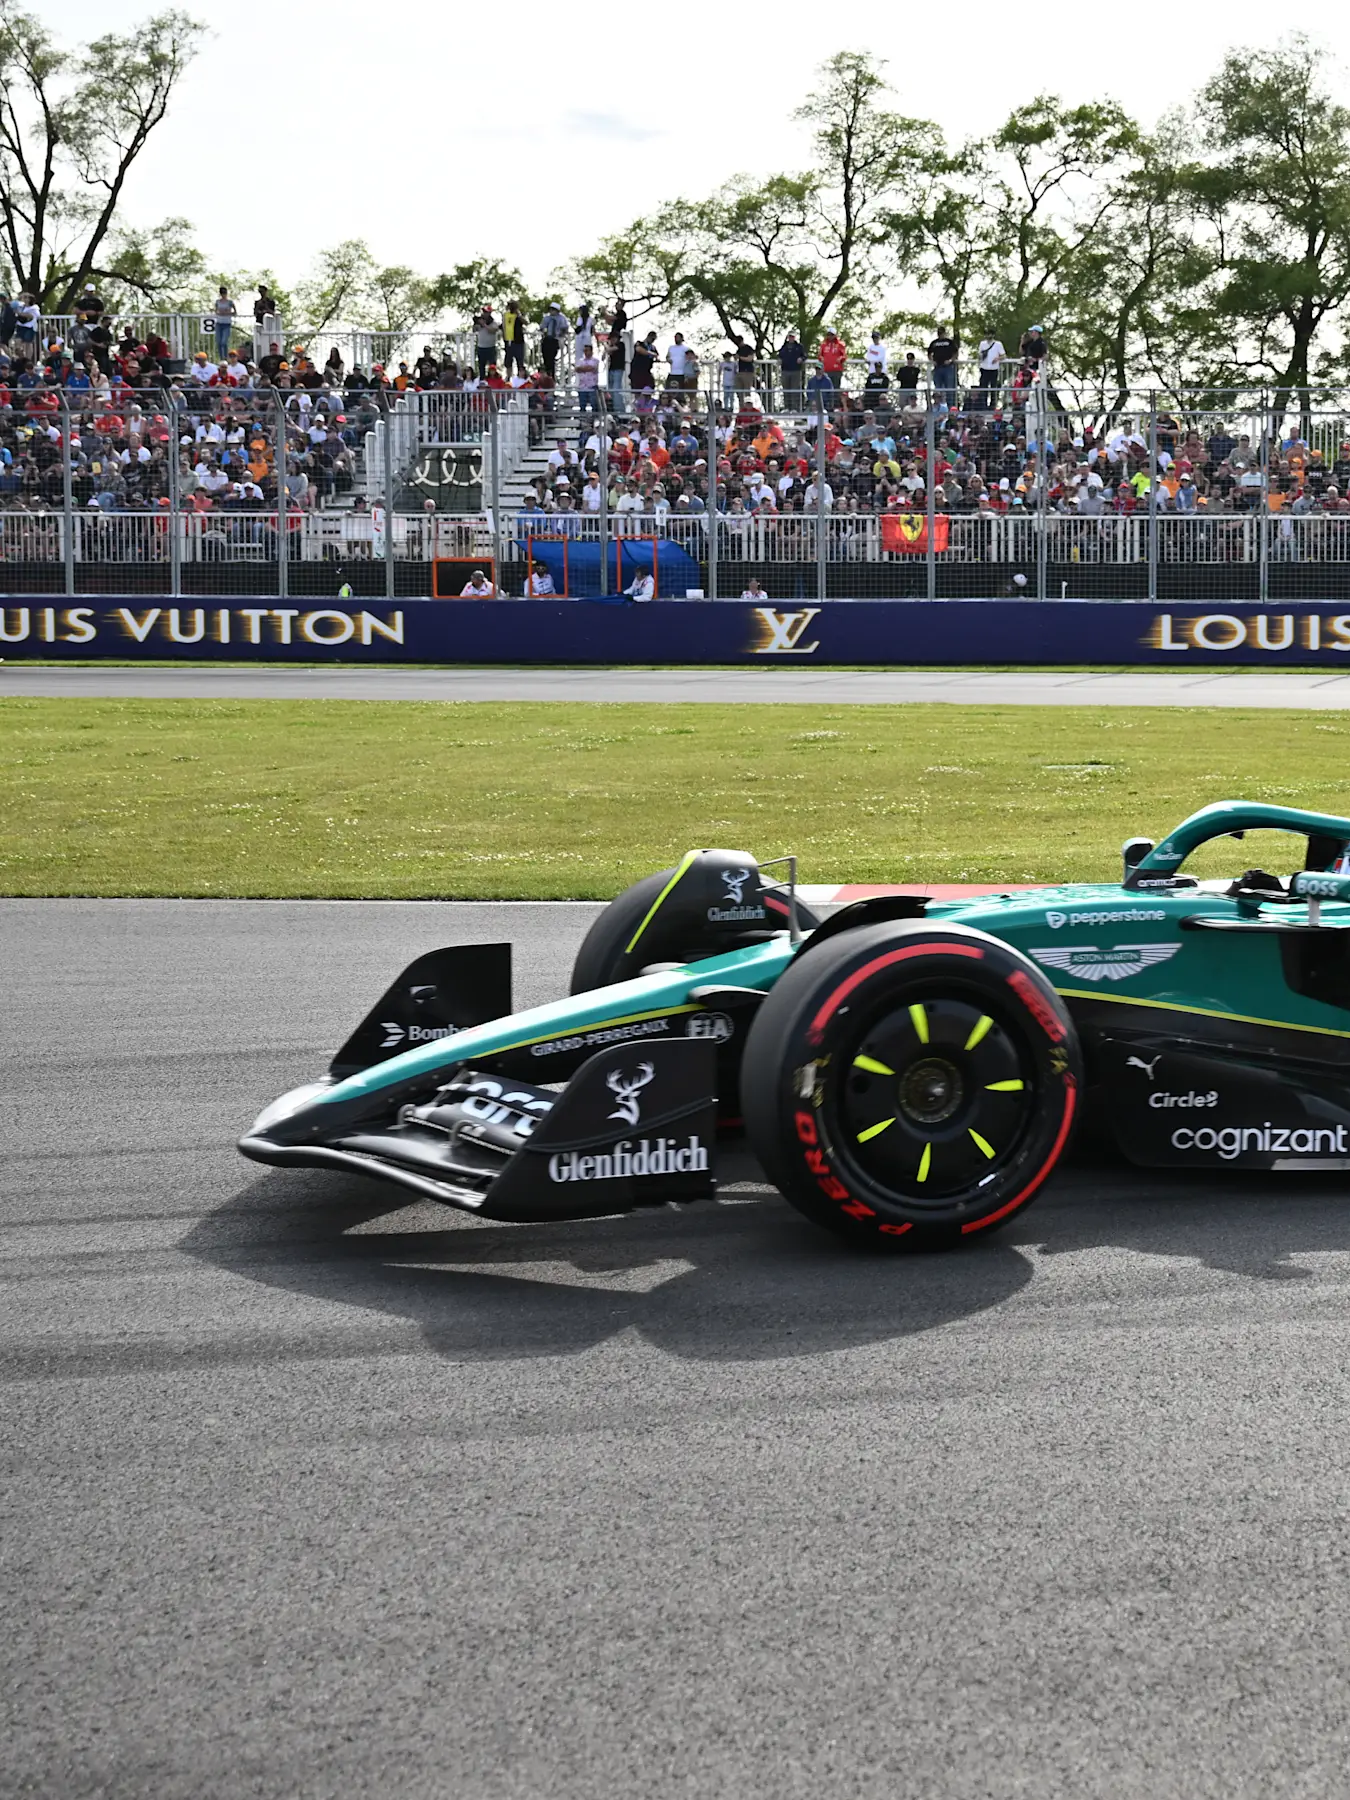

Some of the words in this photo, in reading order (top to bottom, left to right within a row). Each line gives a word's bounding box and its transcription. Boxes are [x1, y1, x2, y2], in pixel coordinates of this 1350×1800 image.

[203, 318, 215, 332] 8
[118, 608, 404, 645] VUITTON
[1296, 880, 1340, 897] BOSS
[1069, 909, 1166, 926] pepperstone
[1071, 953, 1102, 963] ASTON
[1104, 952, 1140, 962] MARTIN
[530, 1019, 670, 1056] GIRARD-PERREGAUX
[1171, 1122, 1348, 1159] cognizant
[549, 1136, 710, 1183] Glenfiddich
